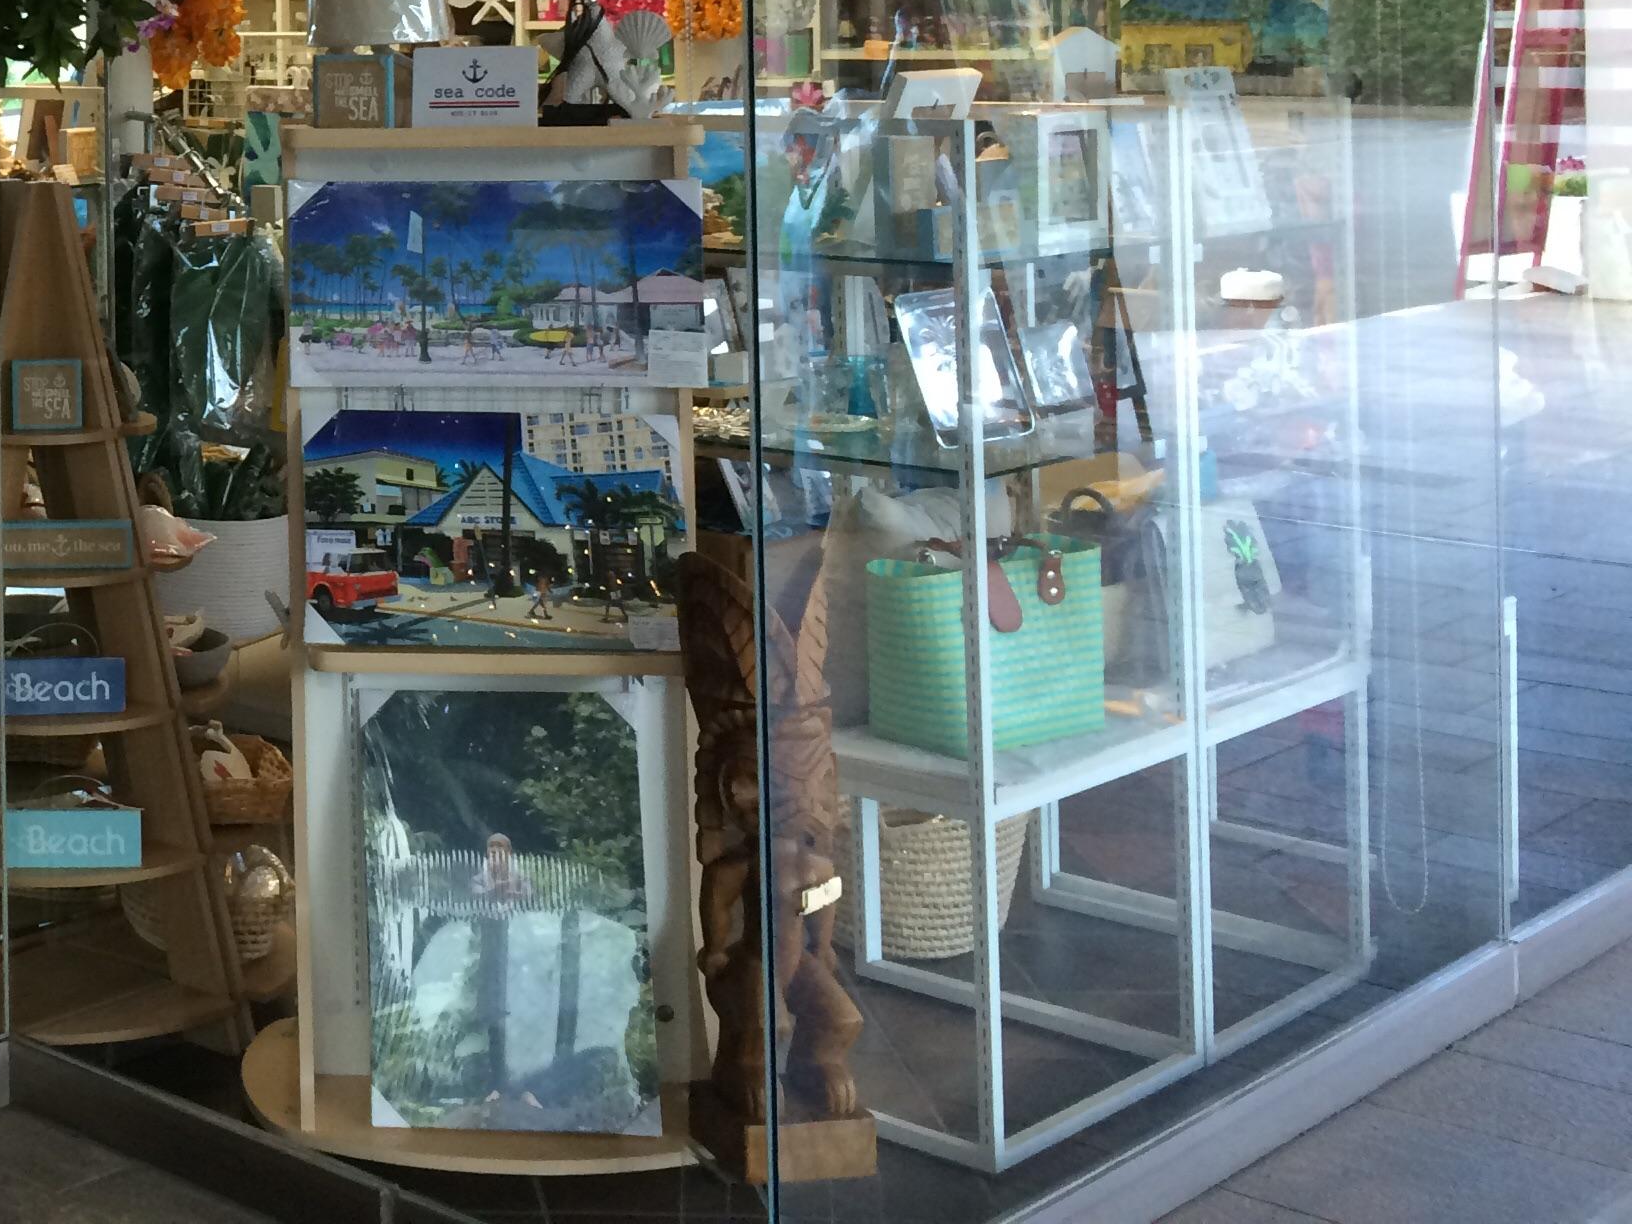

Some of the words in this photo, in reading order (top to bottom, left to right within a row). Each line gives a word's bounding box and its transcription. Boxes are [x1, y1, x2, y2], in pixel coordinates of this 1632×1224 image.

[434, 86, 465, 99] sea
[474, 84, 516, 98] code
[348, 96, 379, 121] SEA
[43, 398, 72, 420] SEA
[484, 516, 516, 525] STOE
[73, 538, 96, 553] the
[13, 671, 111, 703] Beach
[25, 824, 127, 857] Beach
